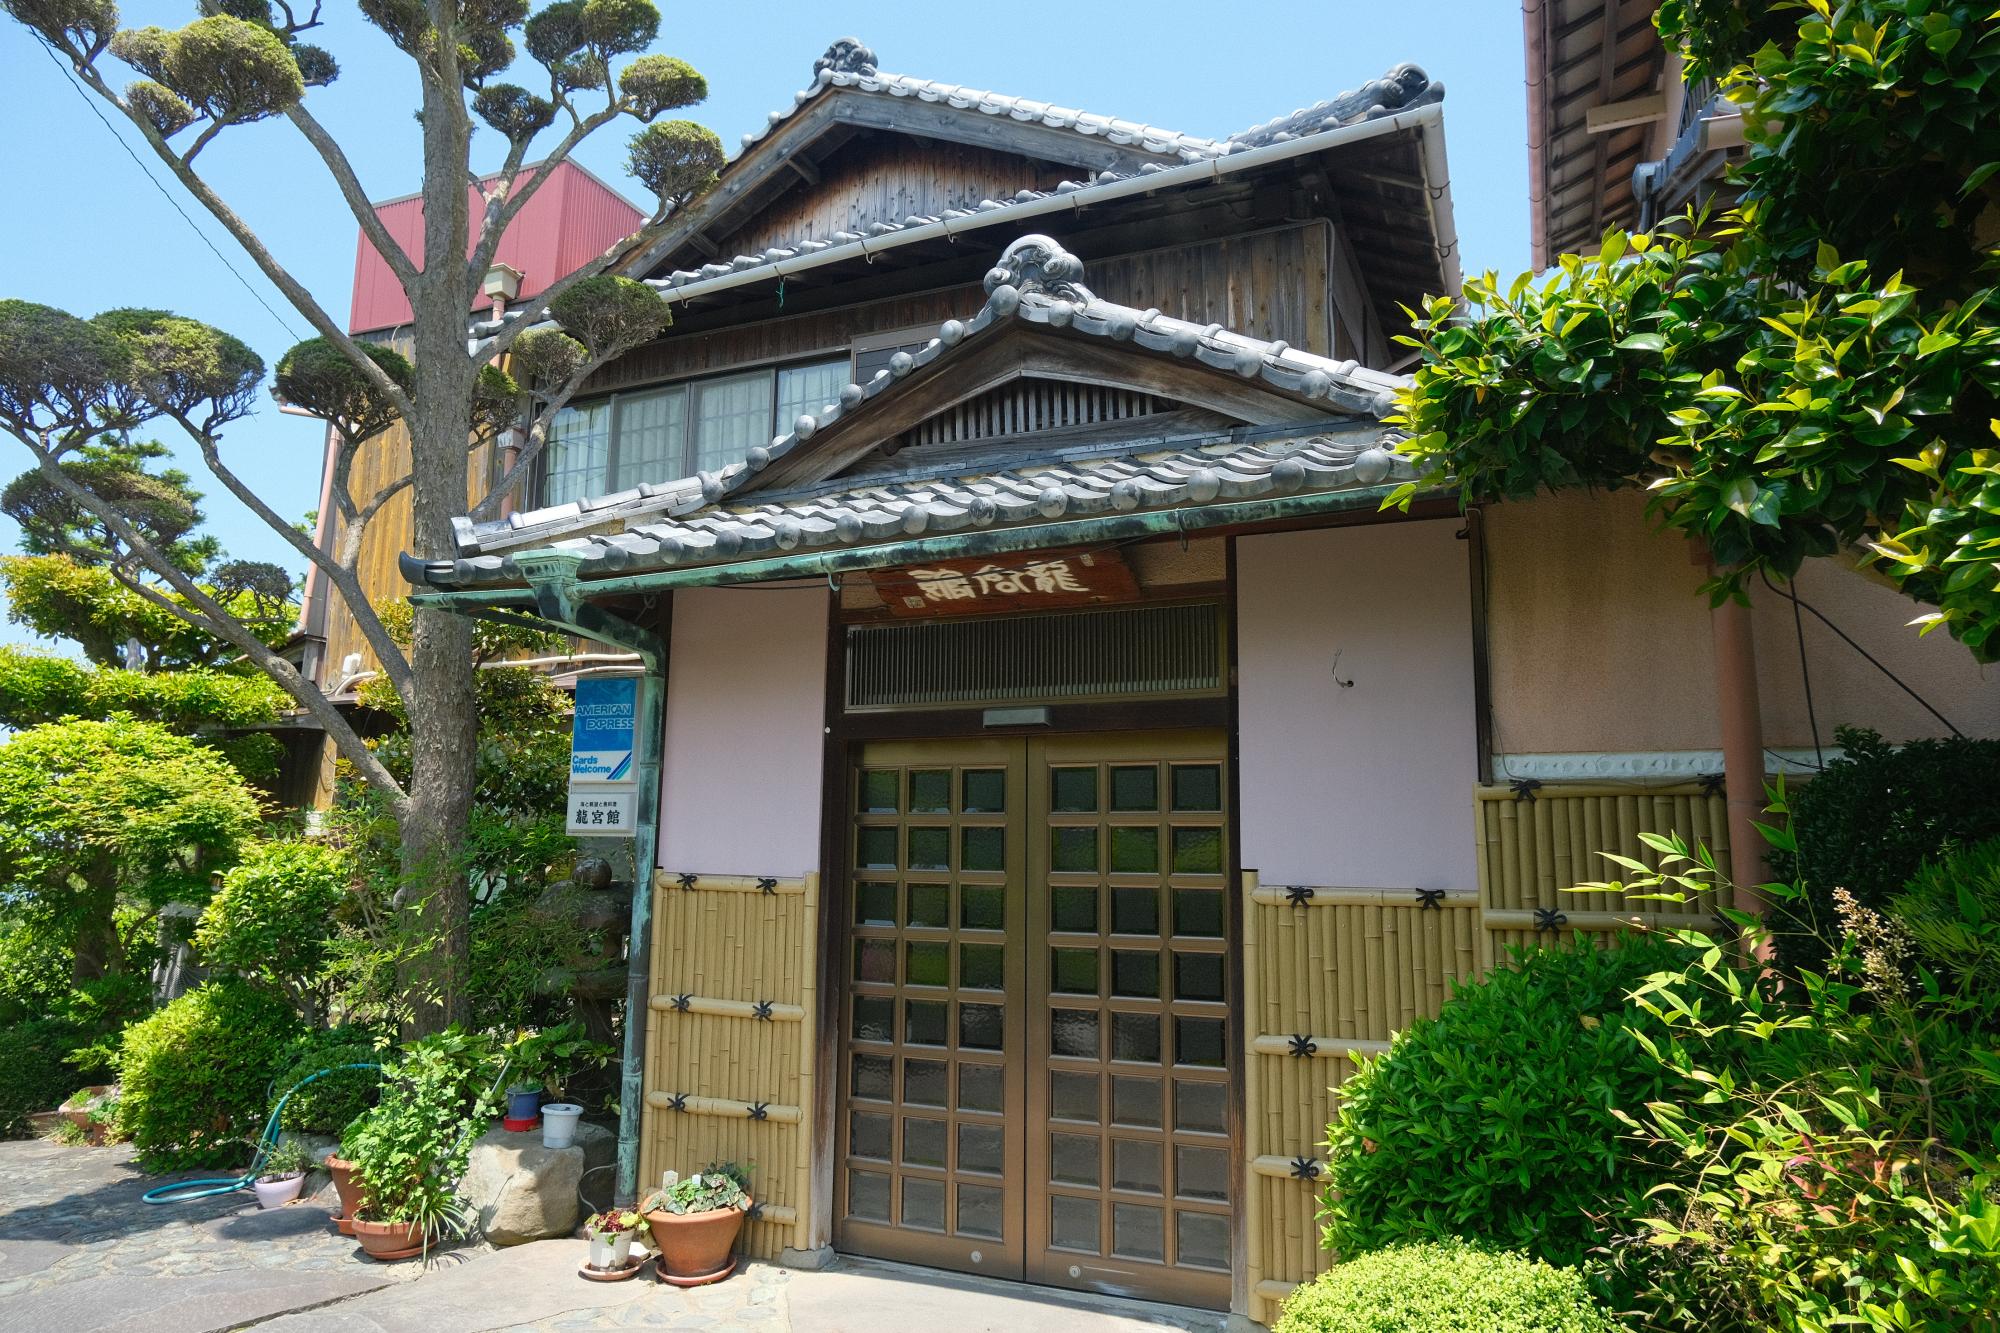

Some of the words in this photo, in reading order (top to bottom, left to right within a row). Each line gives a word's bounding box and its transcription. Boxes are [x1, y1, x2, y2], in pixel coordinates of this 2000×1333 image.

[576, 703, 632, 716] AMERICAN
[586, 717, 635, 730] EXPRESS
[572, 754, 598, 765] Cards
[572, 764, 612, 774] Welcome
[575, 809, 620, 825] 龍宮館
